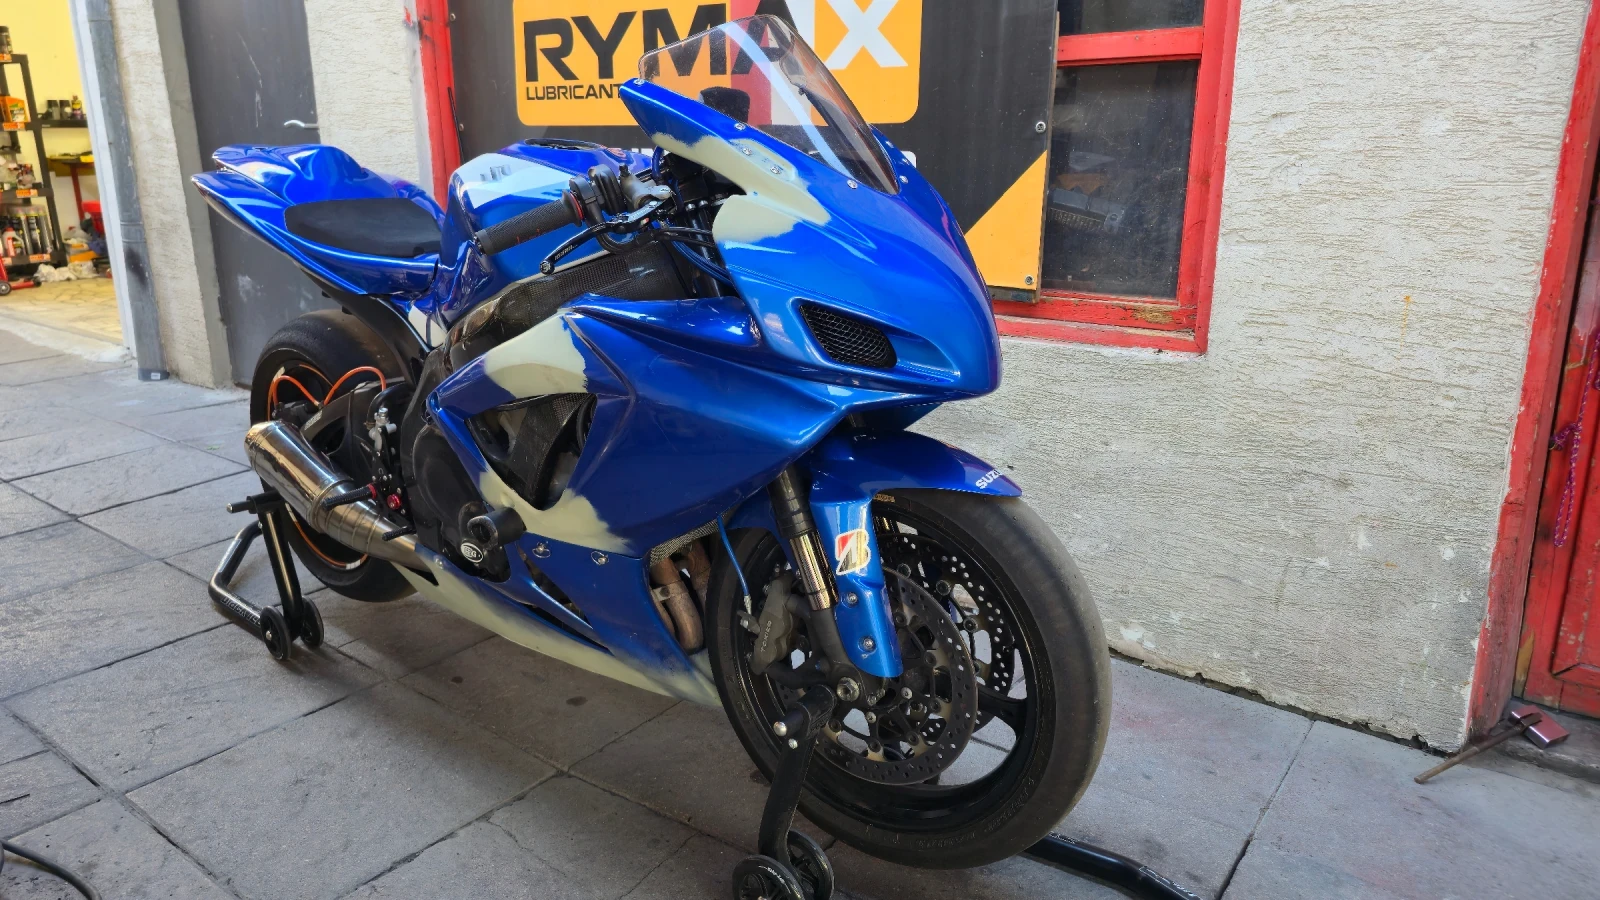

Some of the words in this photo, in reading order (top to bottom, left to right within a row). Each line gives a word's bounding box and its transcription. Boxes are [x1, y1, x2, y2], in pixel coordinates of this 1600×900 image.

[524, 0, 908, 82] RYMAX
[526, 84, 623, 100] LUBRICANT
[976, 470, 1003, 489] SUZ
